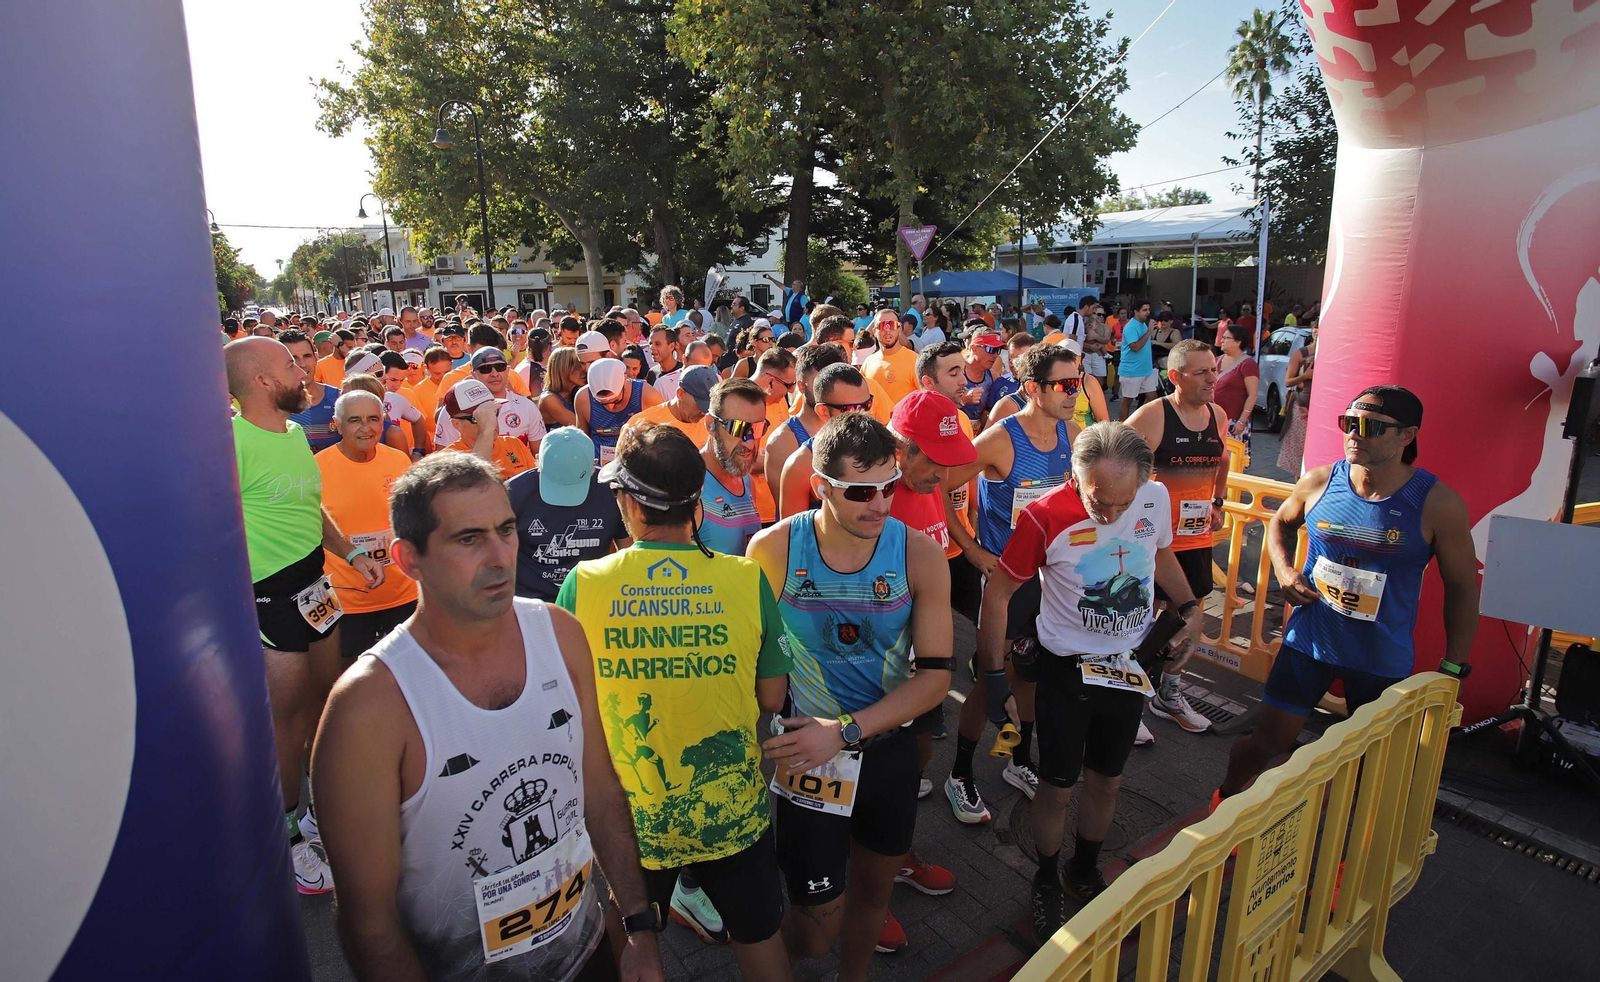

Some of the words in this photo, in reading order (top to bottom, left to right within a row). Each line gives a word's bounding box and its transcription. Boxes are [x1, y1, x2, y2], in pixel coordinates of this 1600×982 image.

[592, 519, 603, 528] 22
[552, 549, 580, 557] bike
[566, 538, 600, 548] swim
[538, 557, 559, 565] run
[620, 584, 714, 596] Construcciones
[1327, 585, 1359, 607] 82
[308, 598, 335, 623] 391
[609, 598, 693, 617] JUCANSUR,
[696, 602, 724, 615] S.L.U.
[1082, 607, 1108, 630] Vive
[1111, 611, 1124, 632] la
[1126, 606, 1149, 629] vida
[604, 624, 728, 649] RUNNERS
[598, 652, 737, 679] BARREÑOS
[1463, 717, 1498, 733] VONYX
[788, 774, 842, 798] 101
[451, 813, 474, 850] XXIV
[471, 754, 538, 812] CARRERA
[482, 889, 496, 900] POR
[498, 884, 512, 895] UNA
[513, 869, 541, 888] SONRISA
[1249, 856, 1297, 902] Ayuntamiento
[1247, 896, 1262, 916] Los
[1265, 869, 1295, 900] Barrios
[499, 871, 584, 942] 274
